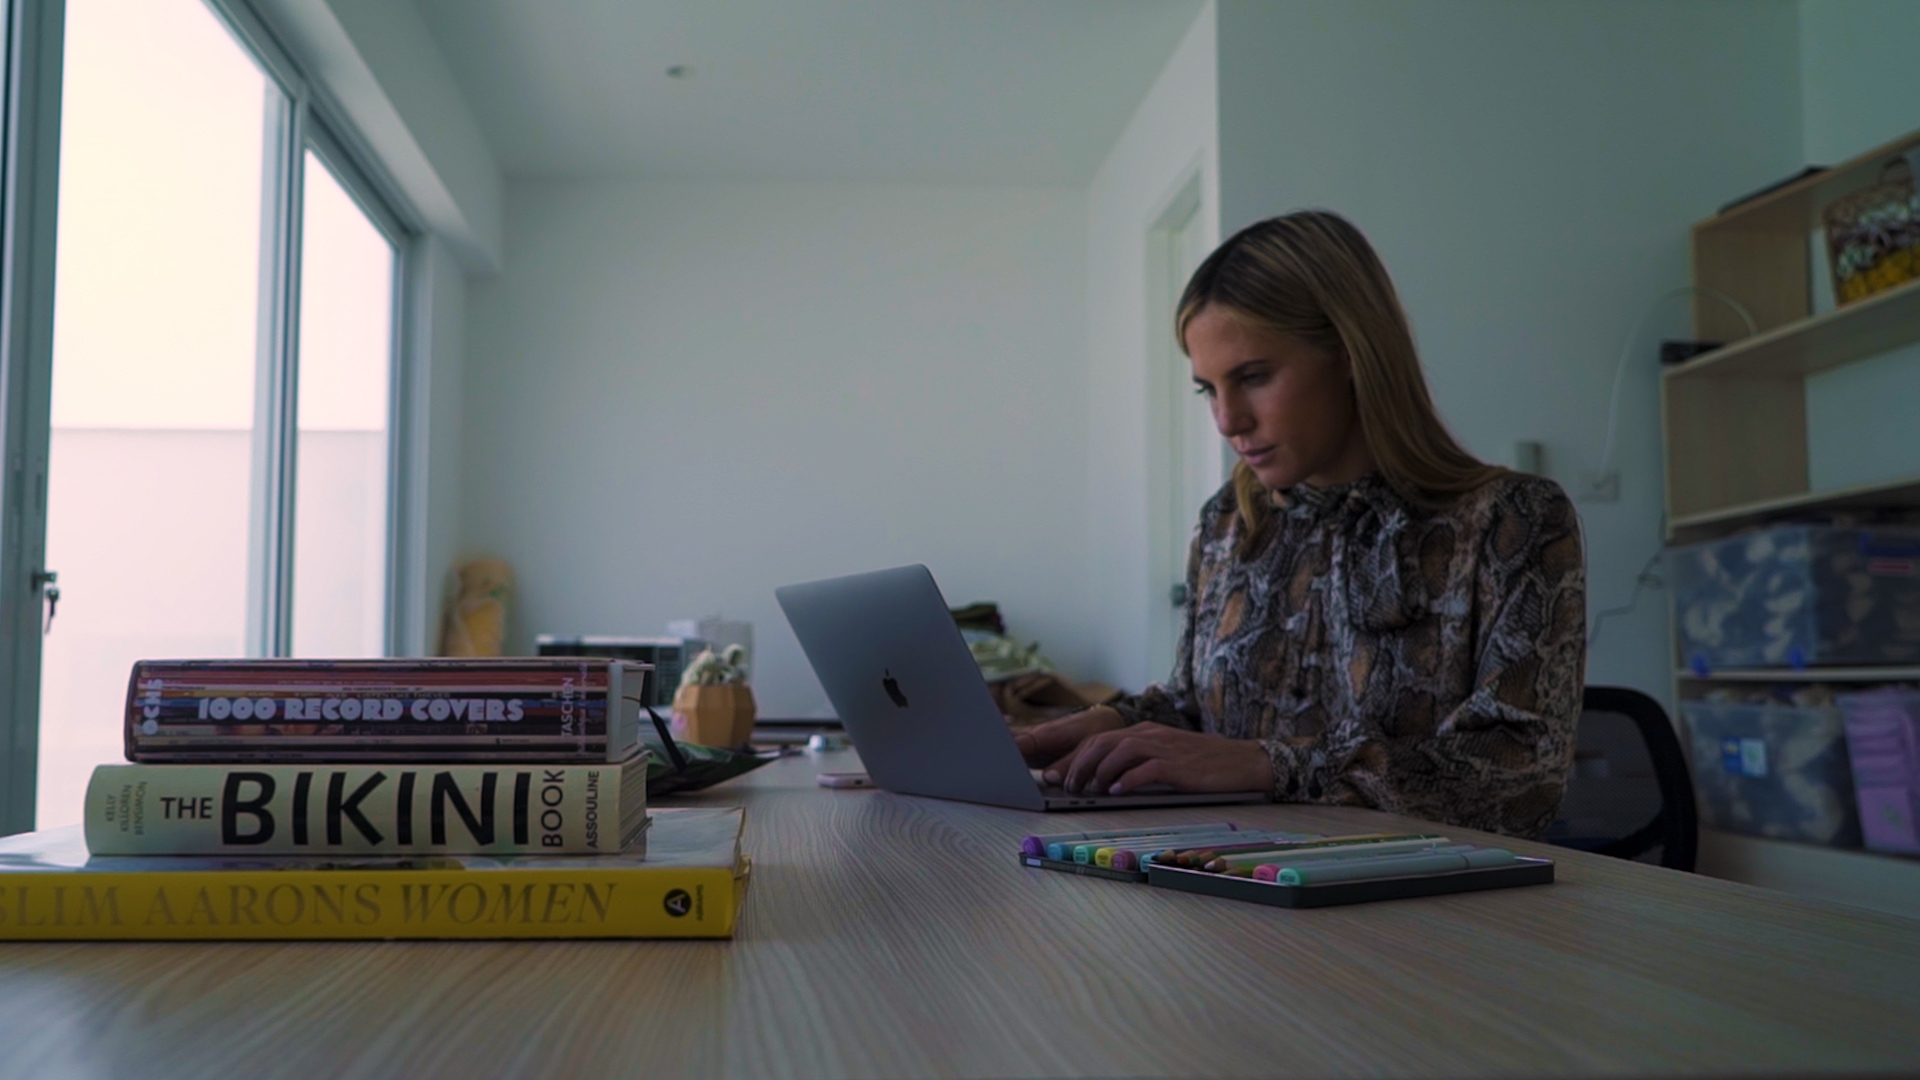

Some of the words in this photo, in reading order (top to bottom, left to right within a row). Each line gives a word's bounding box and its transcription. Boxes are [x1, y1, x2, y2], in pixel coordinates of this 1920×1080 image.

[197, 697, 276, 720] 1000
[283, 697, 403, 721] RECORD
[410, 698, 525, 722] COVERS
[561, 677, 574, 737] TASCHEN
[105, 793, 115, 822] KELLY
[160, 797, 213, 819] THE
[221, 771, 532, 846] BIKINI
[541, 769, 565, 847] BOOK
[586, 770, 600, 848] ASSOULINE
[0, 884, 125, 928] LIM
[144, 883, 382, 928] AARONS
[400, 882, 618, 925] WOMEN
